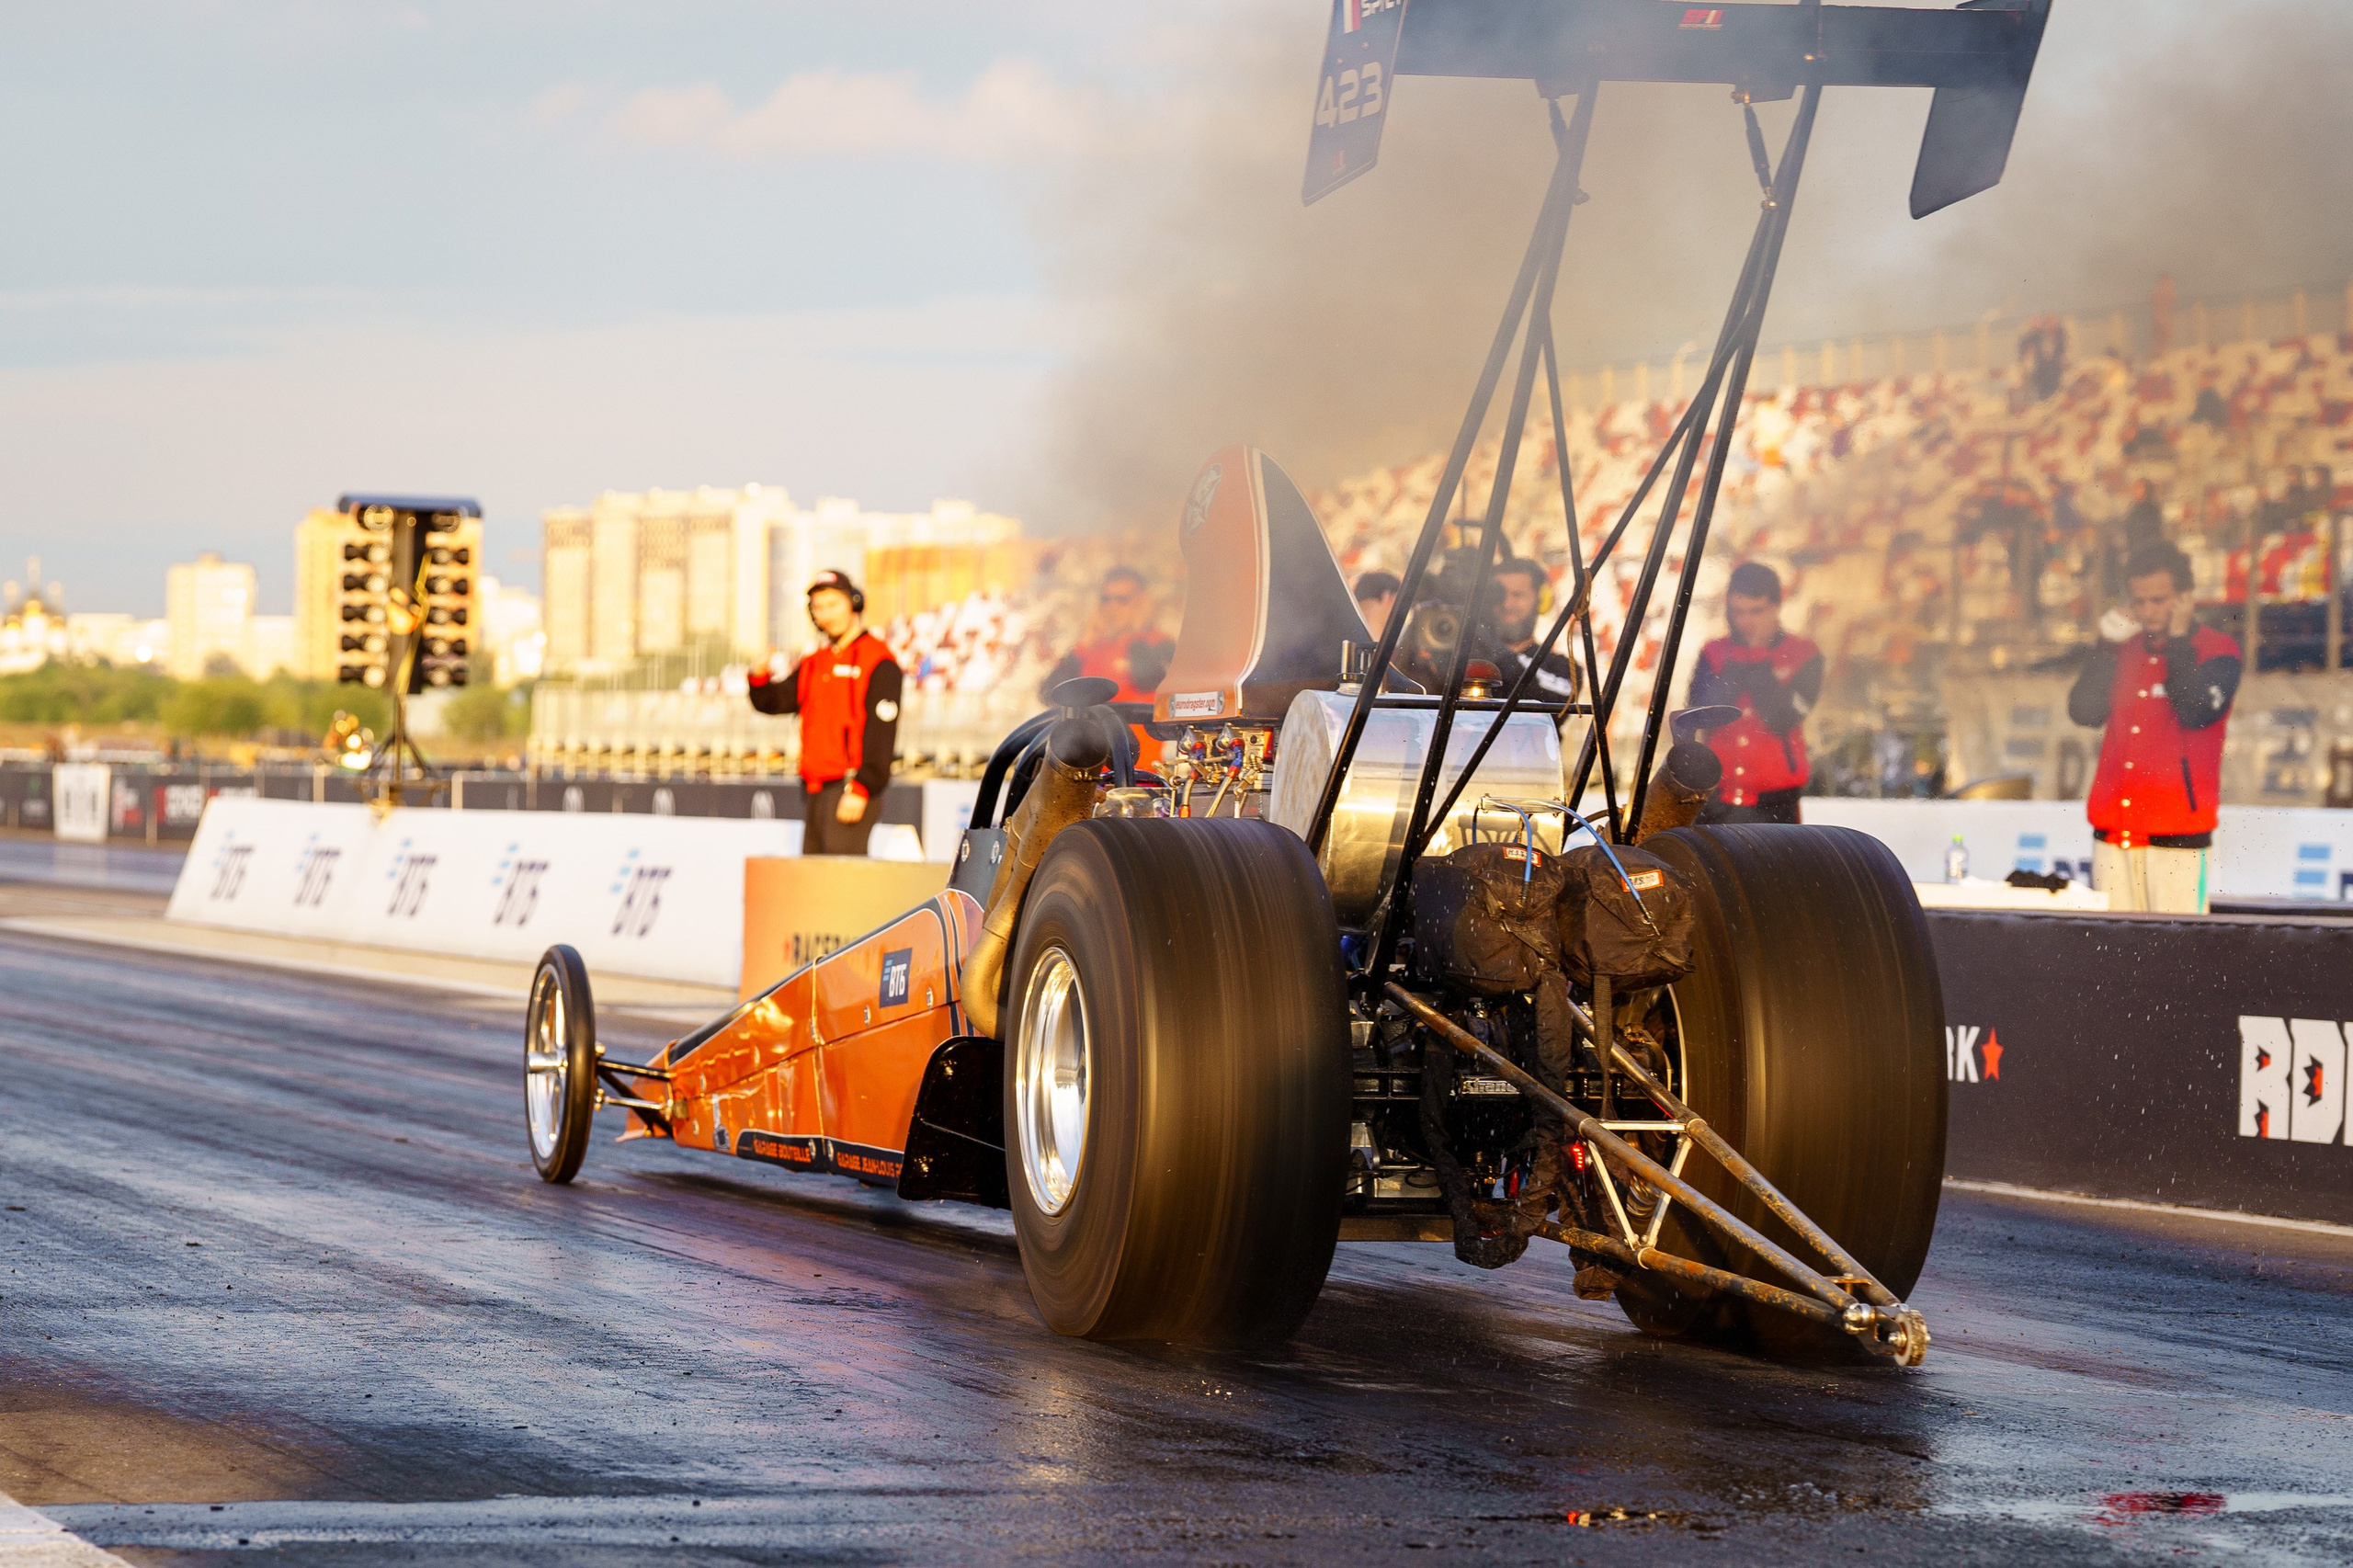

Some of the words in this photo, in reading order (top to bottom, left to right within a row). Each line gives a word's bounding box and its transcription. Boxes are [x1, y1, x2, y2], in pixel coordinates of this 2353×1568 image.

[1316, 61, 1383, 129] 423
[1176, 698, 1216, 710] eurodragster.com
[889, 963, 907, 997] ВТБ
[2238, 1015, 2353, 1147] RD
